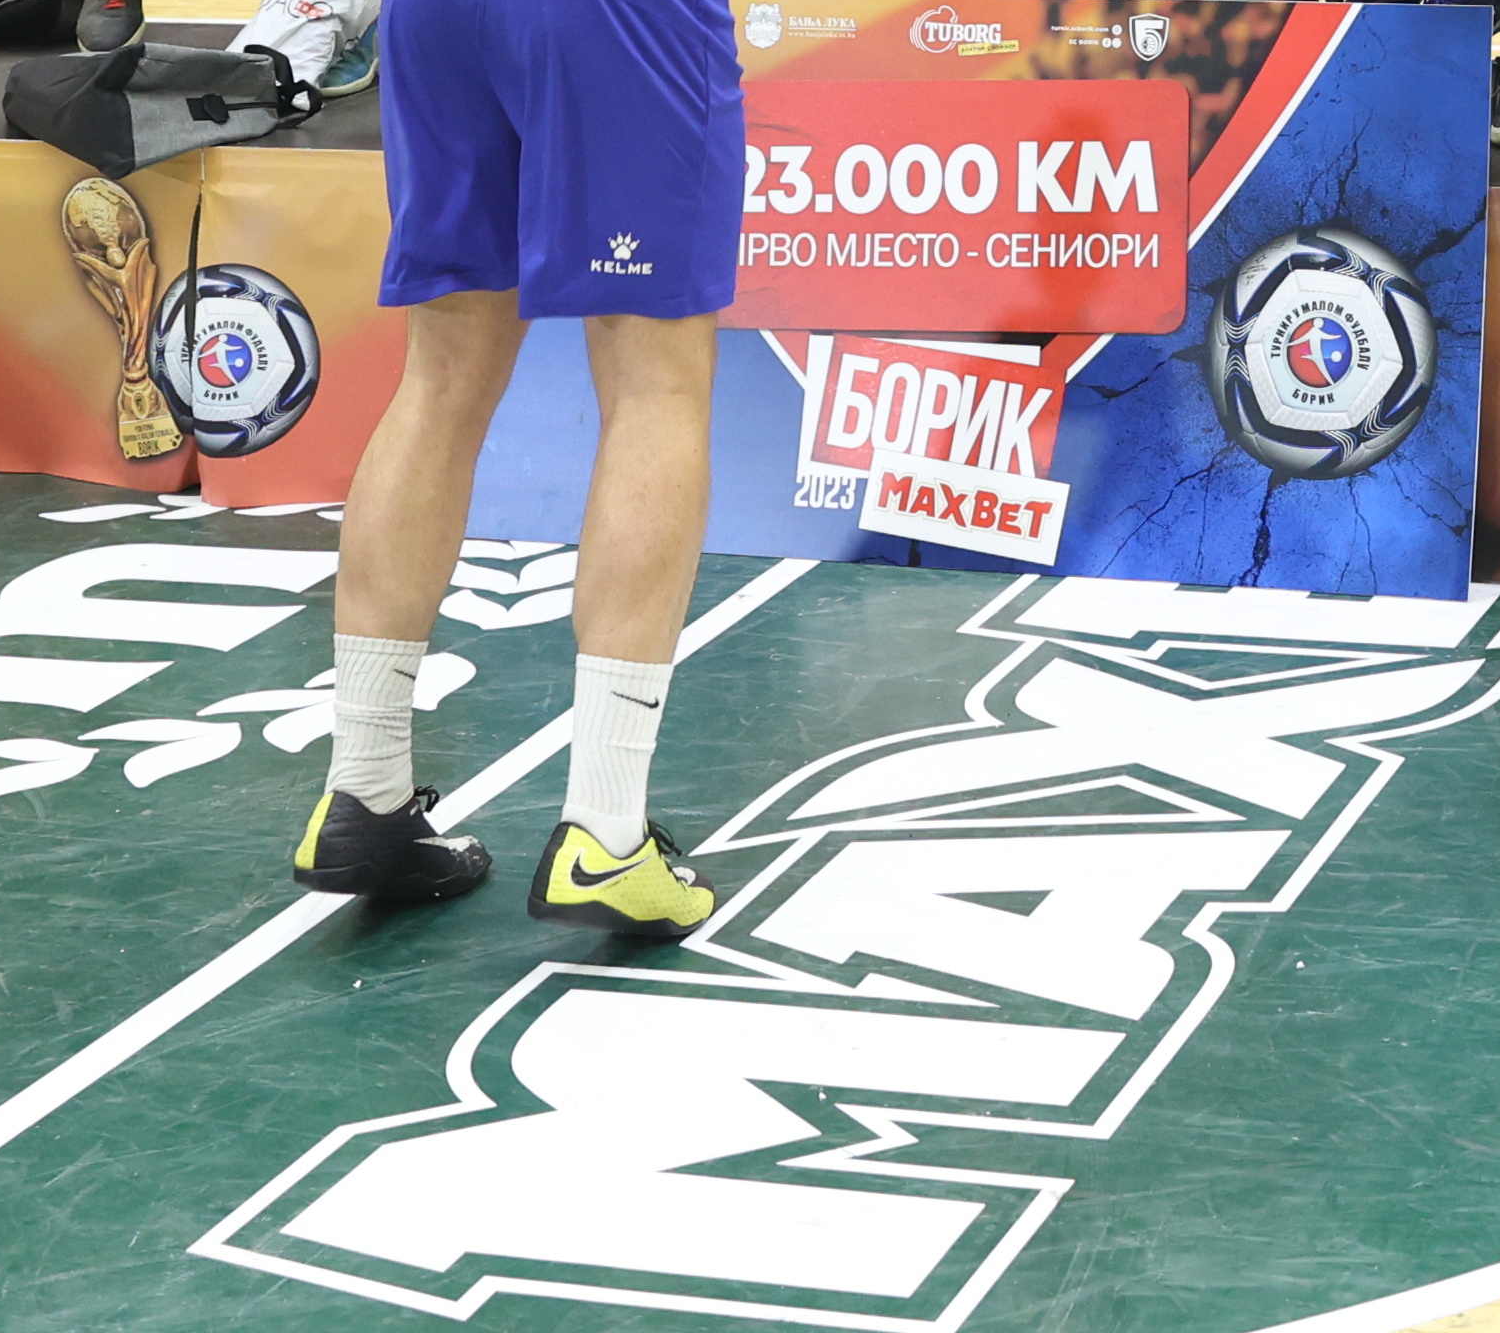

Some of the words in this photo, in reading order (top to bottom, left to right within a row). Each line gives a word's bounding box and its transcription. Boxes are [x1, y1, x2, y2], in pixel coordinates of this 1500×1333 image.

[925, 21, 1002, 44] TUBORG
[825, 232, 961, 268] МЈЕСТО
[985, 233, 1160, 268] СЕНИОРИ
[590, 258, 654, 276] KELME
[1301, 300, 1346, 317] МАЛОМ
[203, 389, 240, 401] БОРИК
[1291, 388, 1336, 406] БОРИК
[825, 353, 1054, 477] БОРИК
[793, 473, 856, 510] 2023
[877, 471, 1055, 540] MAXBET
